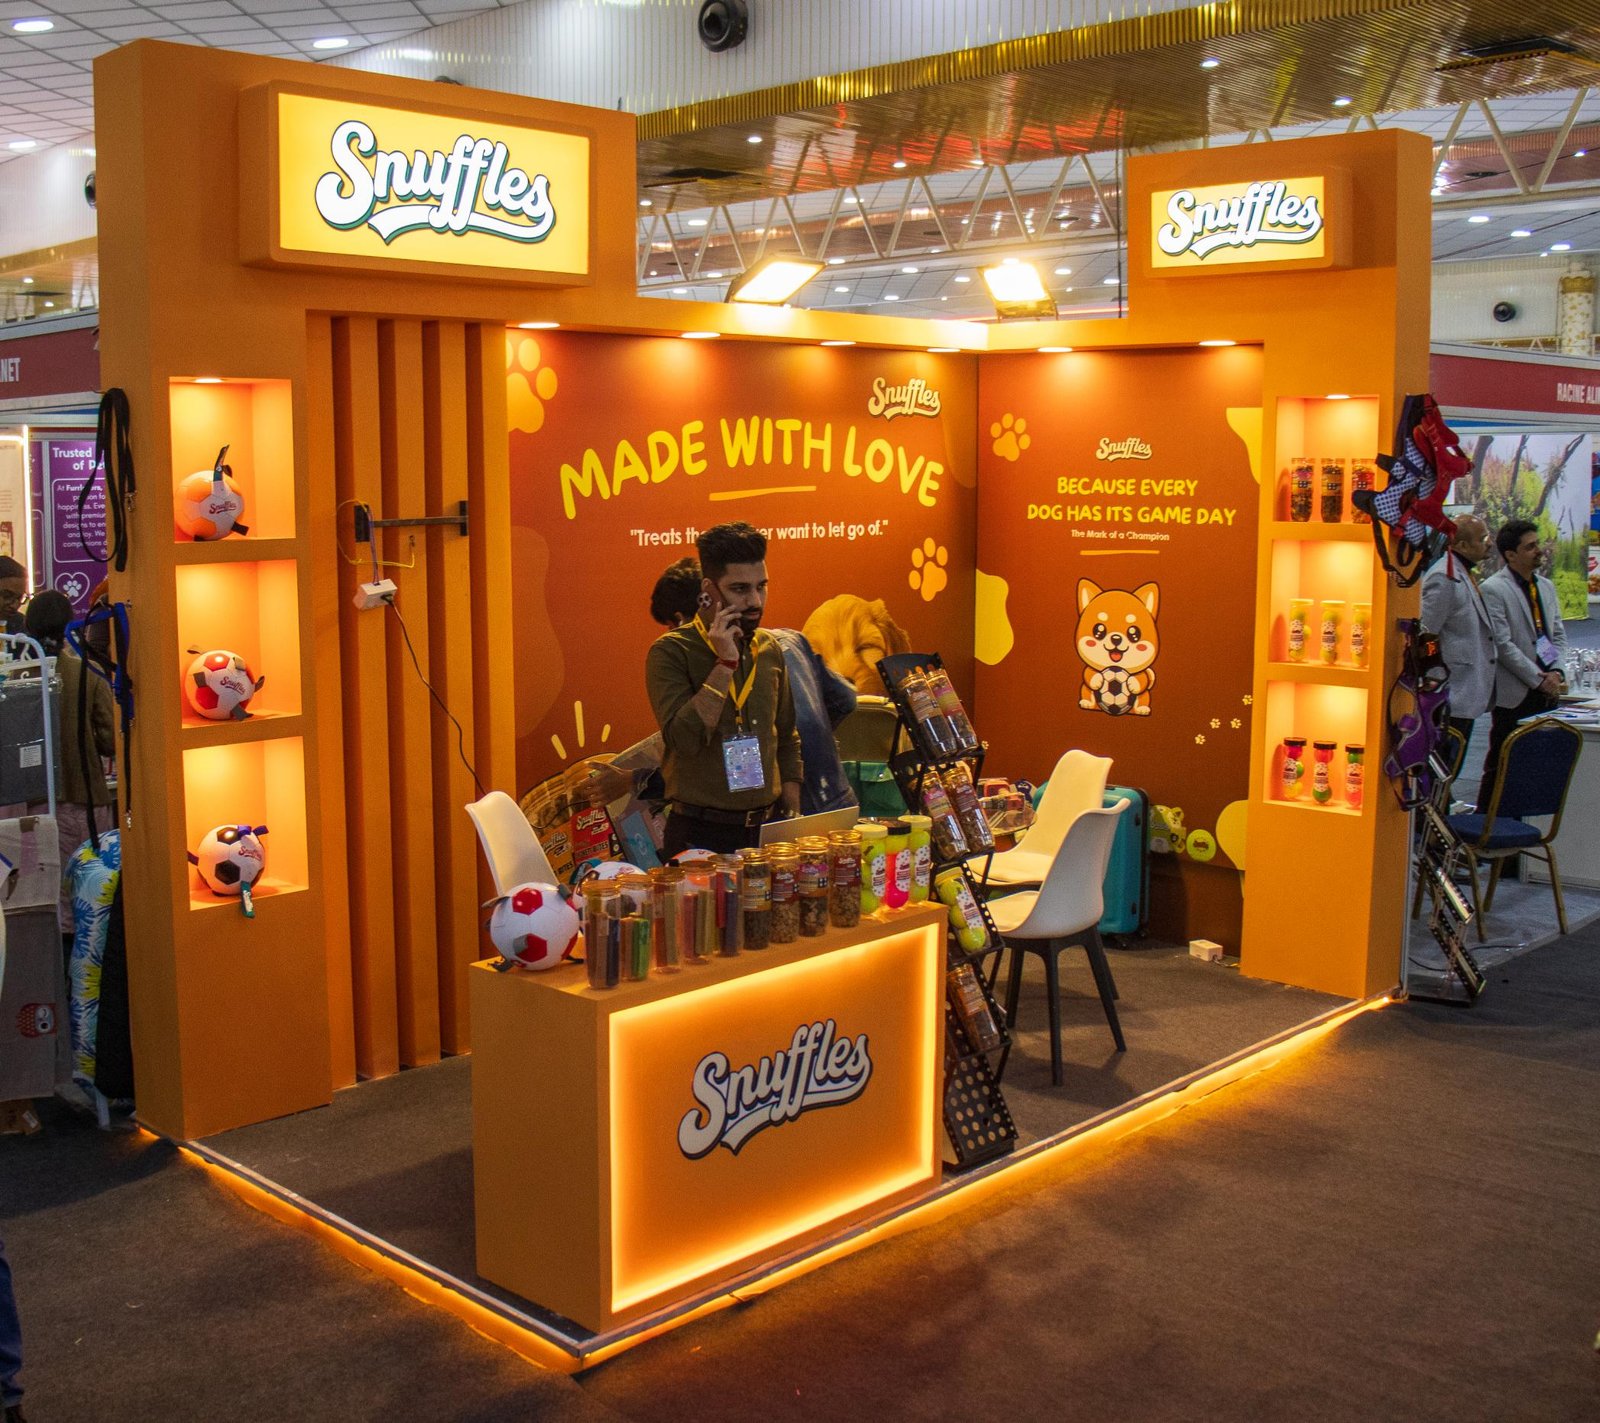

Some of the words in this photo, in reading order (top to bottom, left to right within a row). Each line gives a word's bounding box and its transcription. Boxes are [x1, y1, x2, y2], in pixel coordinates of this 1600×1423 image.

[315, 120, 556, 245] Snuffles
[1157, 181, 1323, 261] Snuffles
[0, 357, 21, 382] NET
[868, 377, 941, 421] Snuffles
[52, 447, 92, 458] Trusted
[1095, 437, 1152, 462] Snuffles
[73, 460, 85, 470] of
[560, 420, 708, 519] MADE
[719, 415, 832, 473] WITH
[843, 425, 944, 507] LOVE
[1057, 476, 1136, 495] BECAUSE
[1140, 479, 1198, 496] EVERY
[1027, 504, 1063, 521] DOG
[1066, 505, 1102, 522] HAS
[1106, 506, 1133, 522] ITS
[1137, 506, 1191, 525] GAME
[1196, 508, 1236, 526] DAY
[630, 528, 682, 546] "Treats
[776, 523, 809, 540] want
[812, 523, 825, 538] to
[828, 522, 845, 537] let
[847, 524, 865, 540] go
[867, 520, 889, 535] of."
[1071, 529, 1085, 538] The
[1086, 530, 1107, 539] Mark
[1108, 530, 1117, 539] of
[1126, 531, 1170, 542] Champion
[677, 1018, 873, 1160] Snuffles
